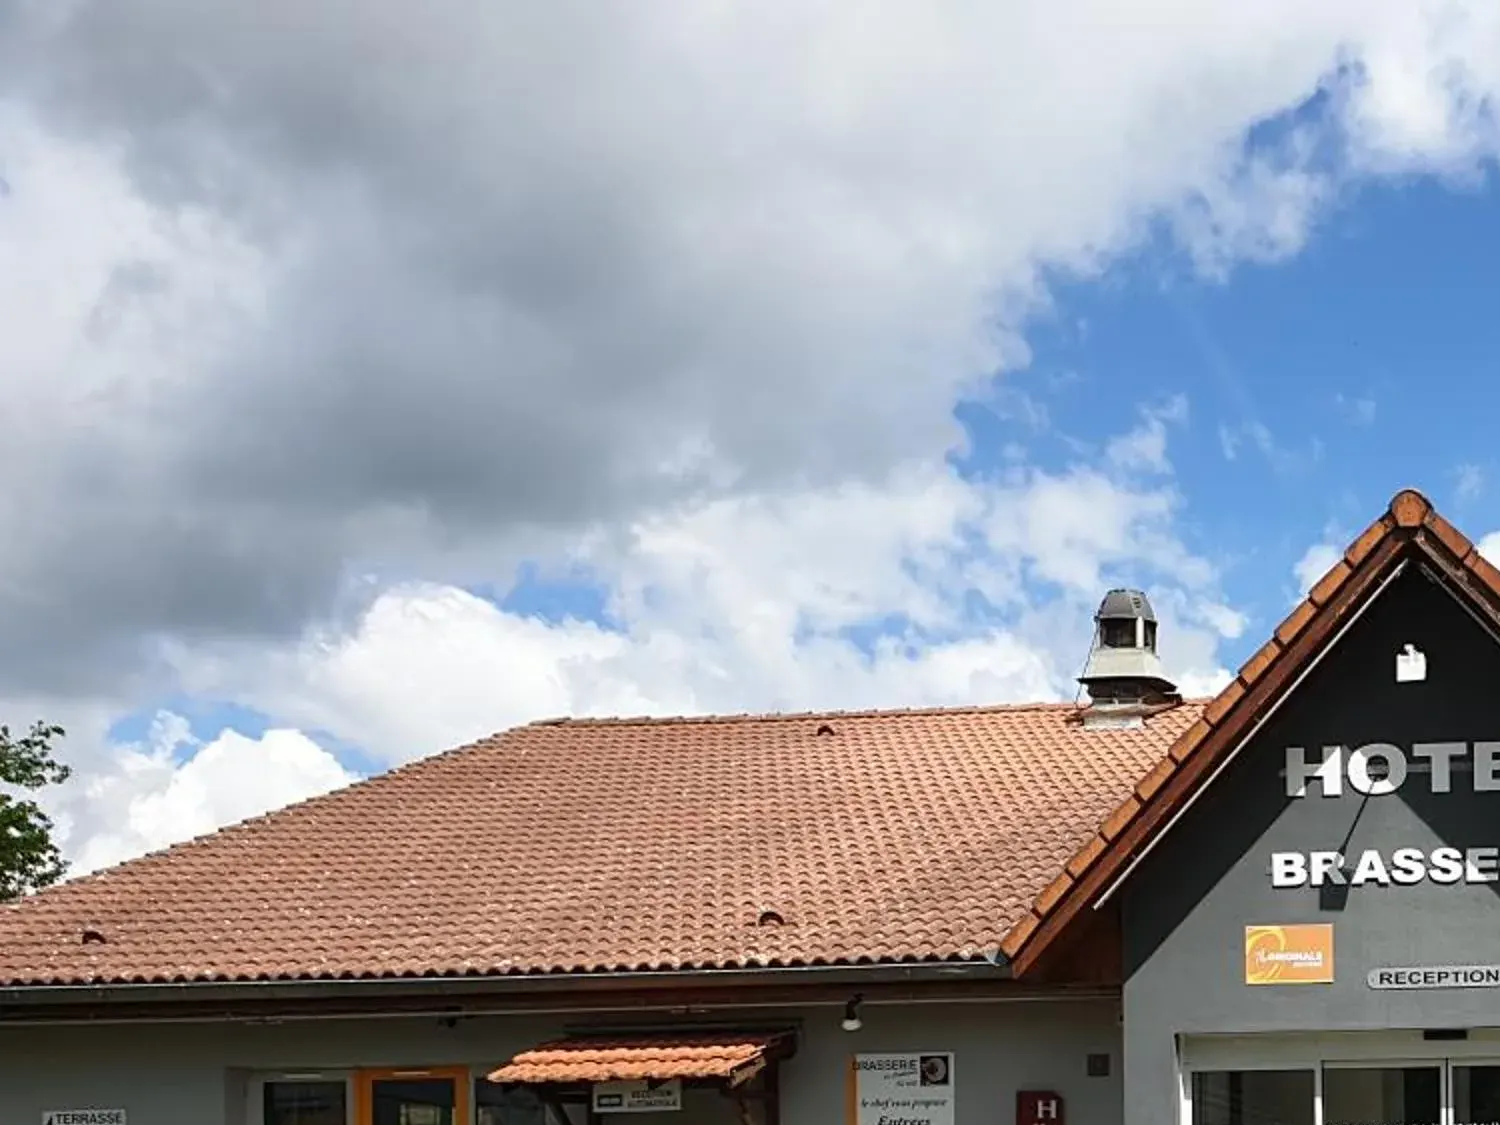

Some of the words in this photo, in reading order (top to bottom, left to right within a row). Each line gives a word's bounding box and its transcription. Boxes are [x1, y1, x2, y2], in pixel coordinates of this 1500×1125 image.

[1379, 969, 1499, 985] RECEPTION
[1037, 1099, 1057, 1119] H
[56, 1112, 124, 1125] TERRASSE
